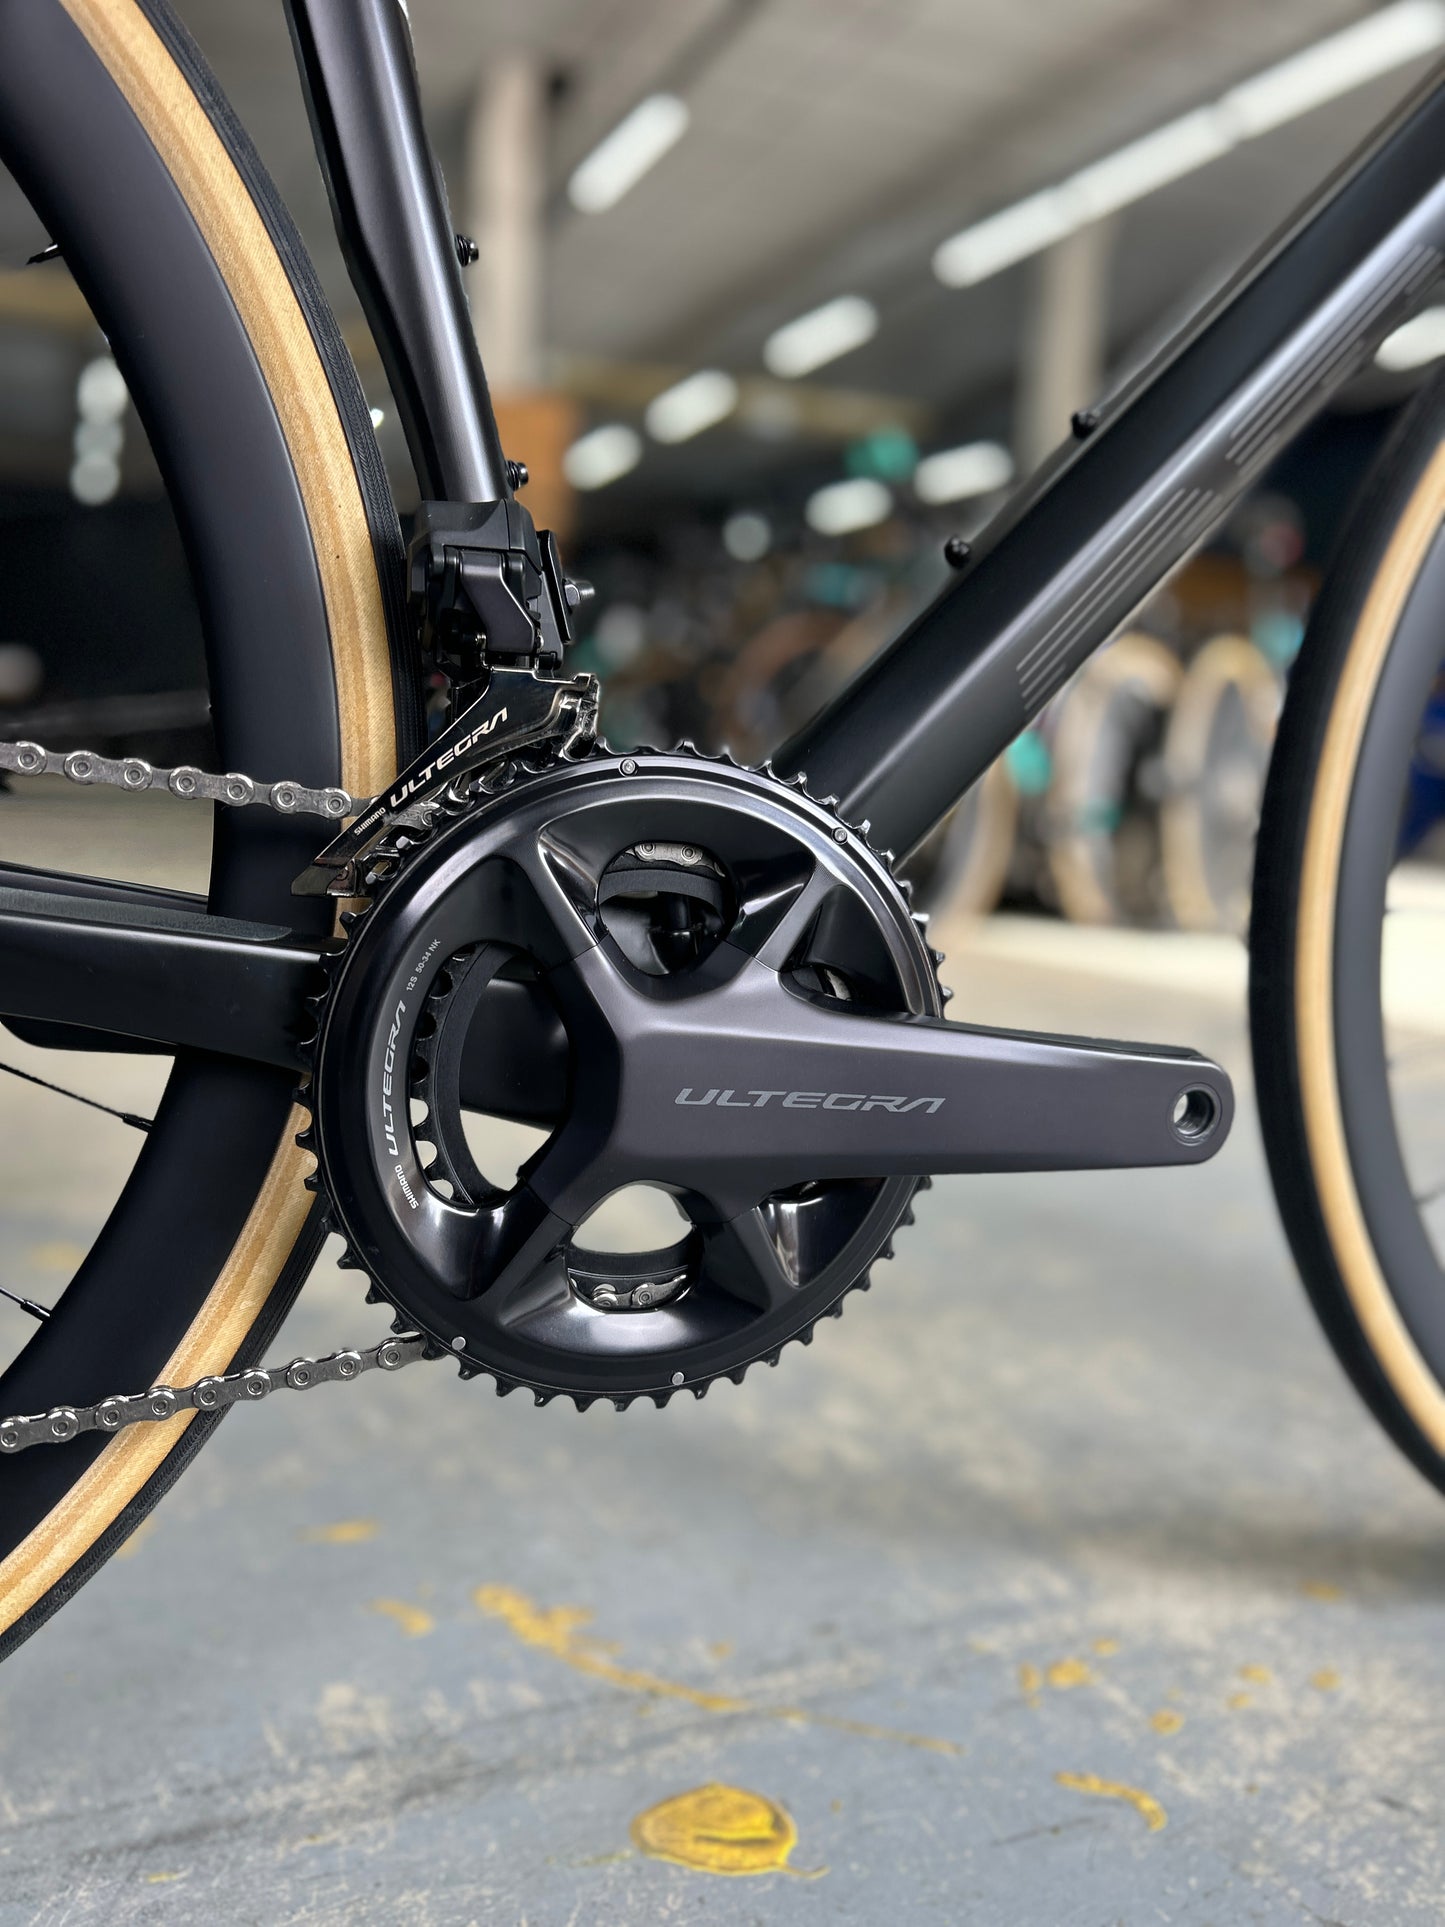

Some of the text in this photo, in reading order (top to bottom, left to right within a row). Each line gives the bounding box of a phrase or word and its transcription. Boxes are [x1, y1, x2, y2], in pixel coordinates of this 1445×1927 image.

[354, 707, 508, 836] SHIMANO ULTEGRA
[383, 939, 441, 1210] SHIMANO ULTEGRA 12S 50-34 NK
[674, 1088, 946, 1113] ULTEGRA
